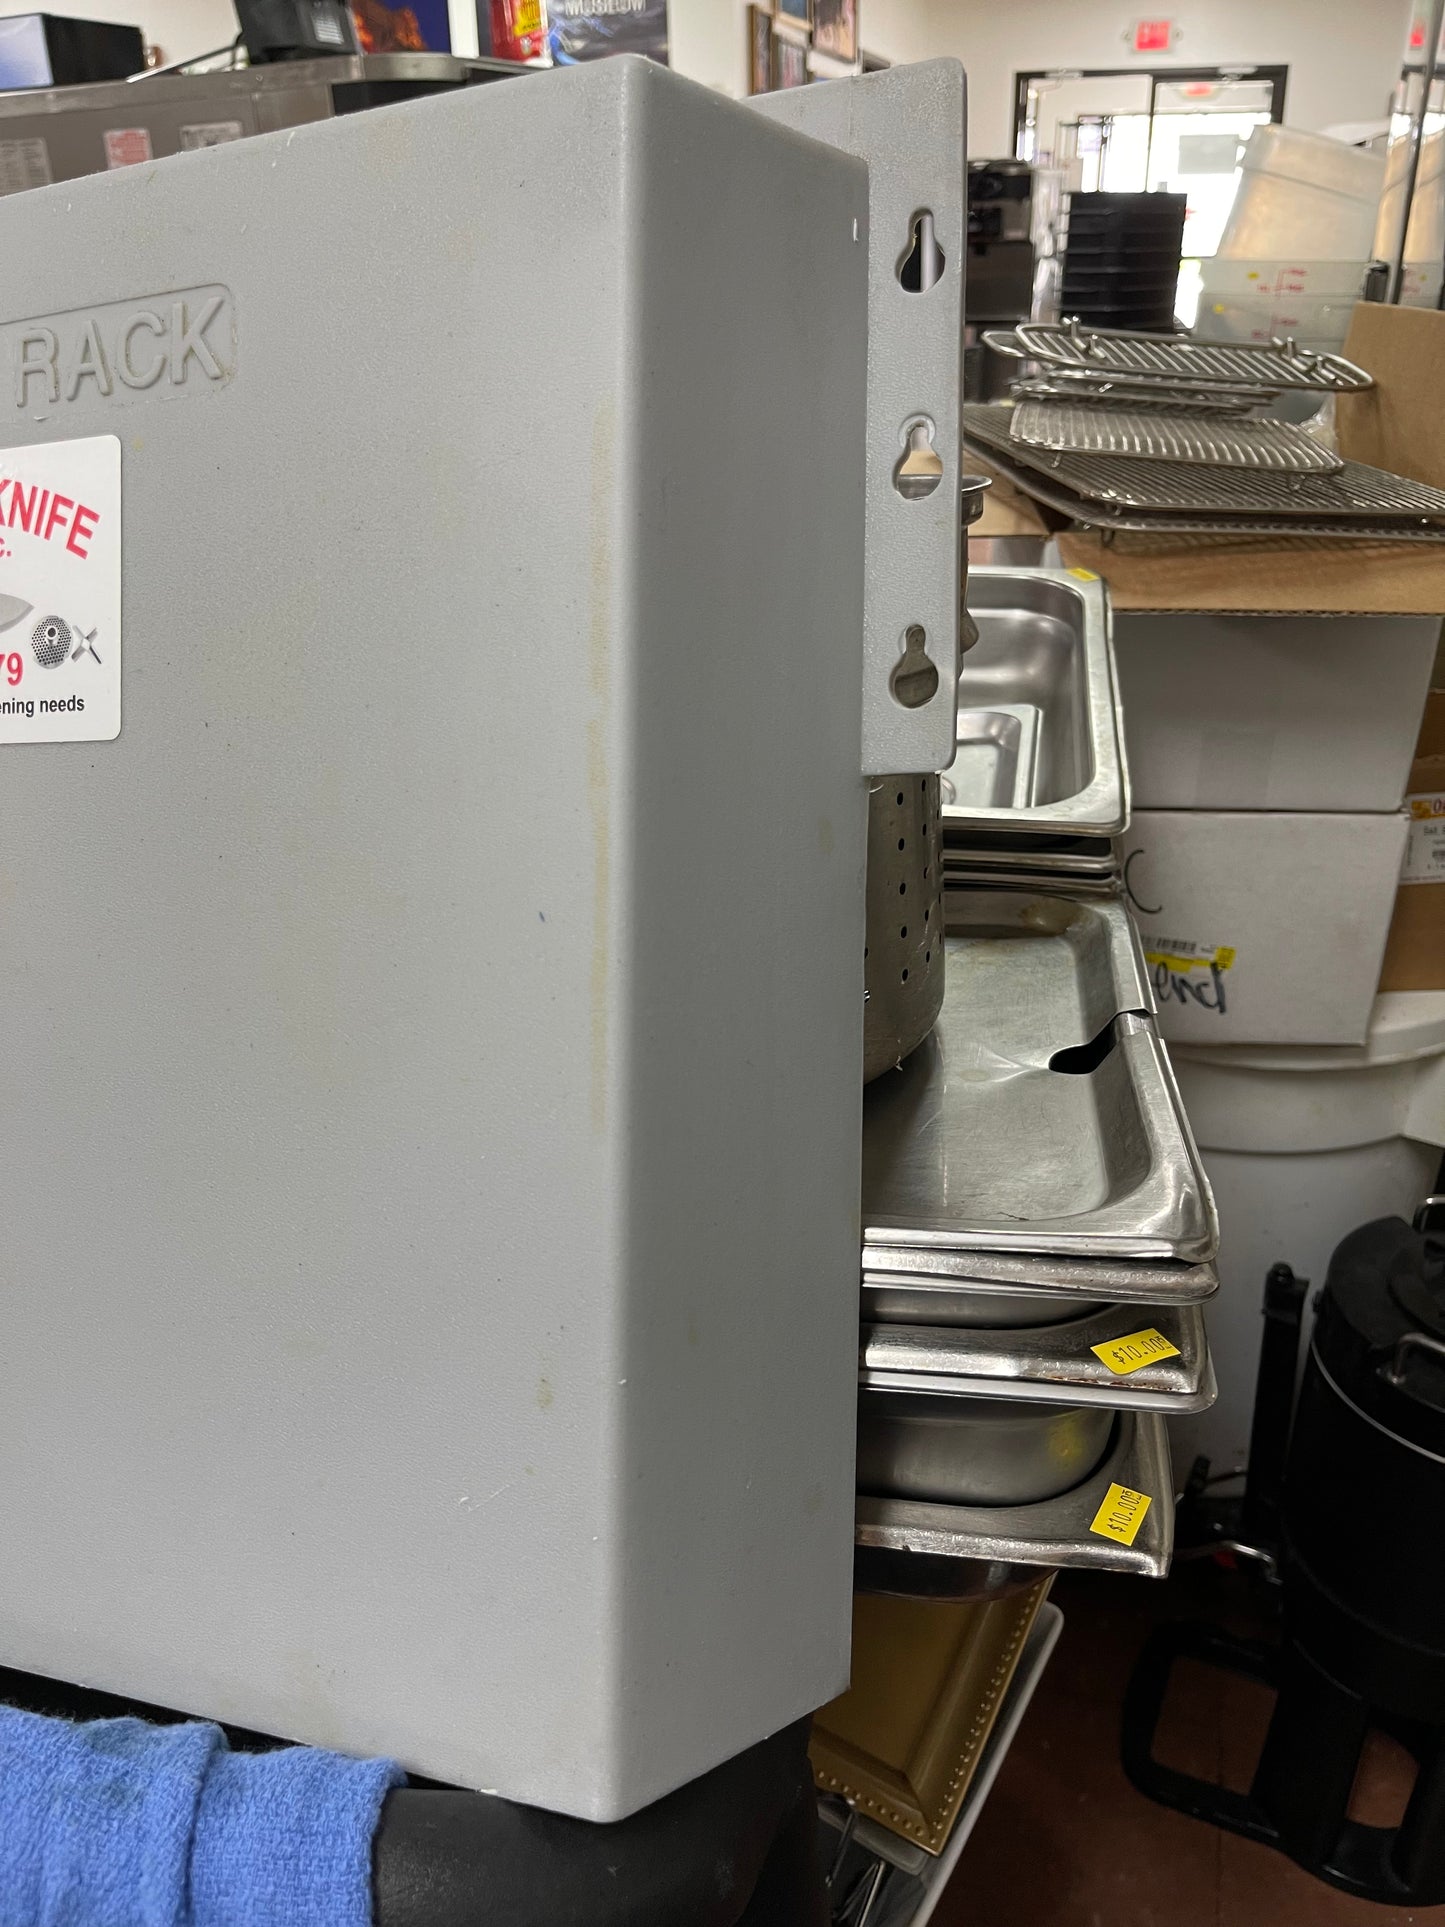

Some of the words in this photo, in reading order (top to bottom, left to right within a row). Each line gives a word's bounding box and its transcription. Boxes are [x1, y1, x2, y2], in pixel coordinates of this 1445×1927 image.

[16, 297, 224, 408] RACK
[0, 697, 34, 718] ning
[39, 694, 85, 713] needs
[1111, 1337, 1165, 1365] $10.00
[1107, 1494, 1140, 1533] $10.00
